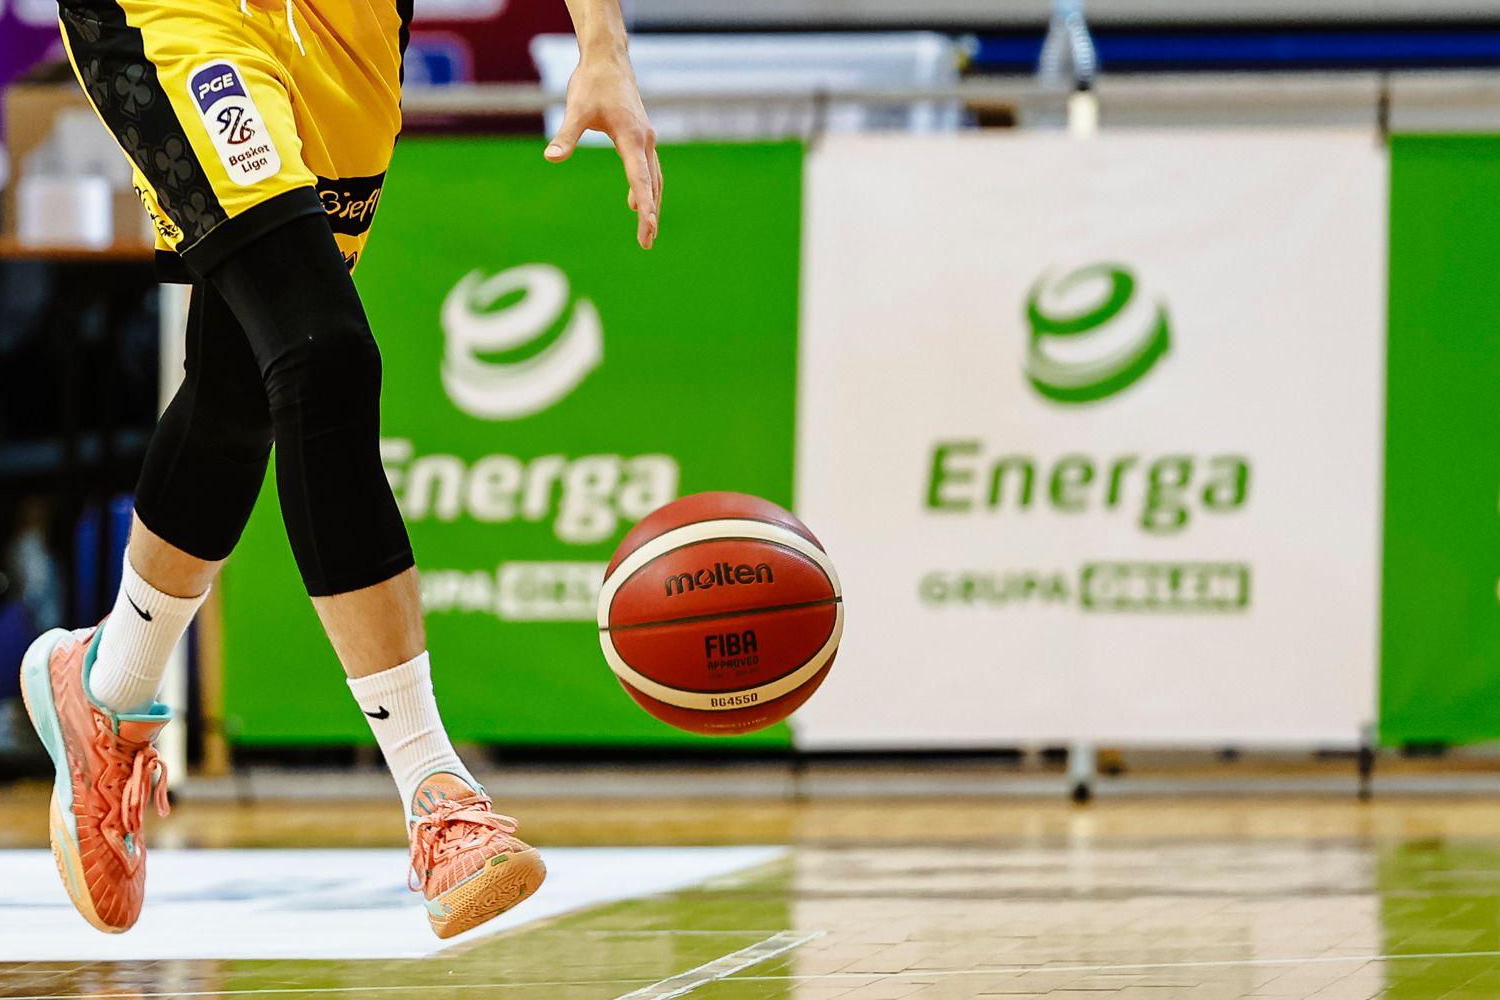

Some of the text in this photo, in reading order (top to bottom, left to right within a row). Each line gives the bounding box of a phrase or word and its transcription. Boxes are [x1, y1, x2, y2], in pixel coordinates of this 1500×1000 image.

[198, 72, 235, 100] PGE
[228, 143, 271, 168] Basket
[242, 156, 269, 174] Liga
[922, 438, 1251, 535] Energa
[664, 562, 774, 598] molten
[917, 570, 1070, 609] GRUPA
[704, 629, 759, 659] FIBA
[707, 655, 760, 671] APPROVED
